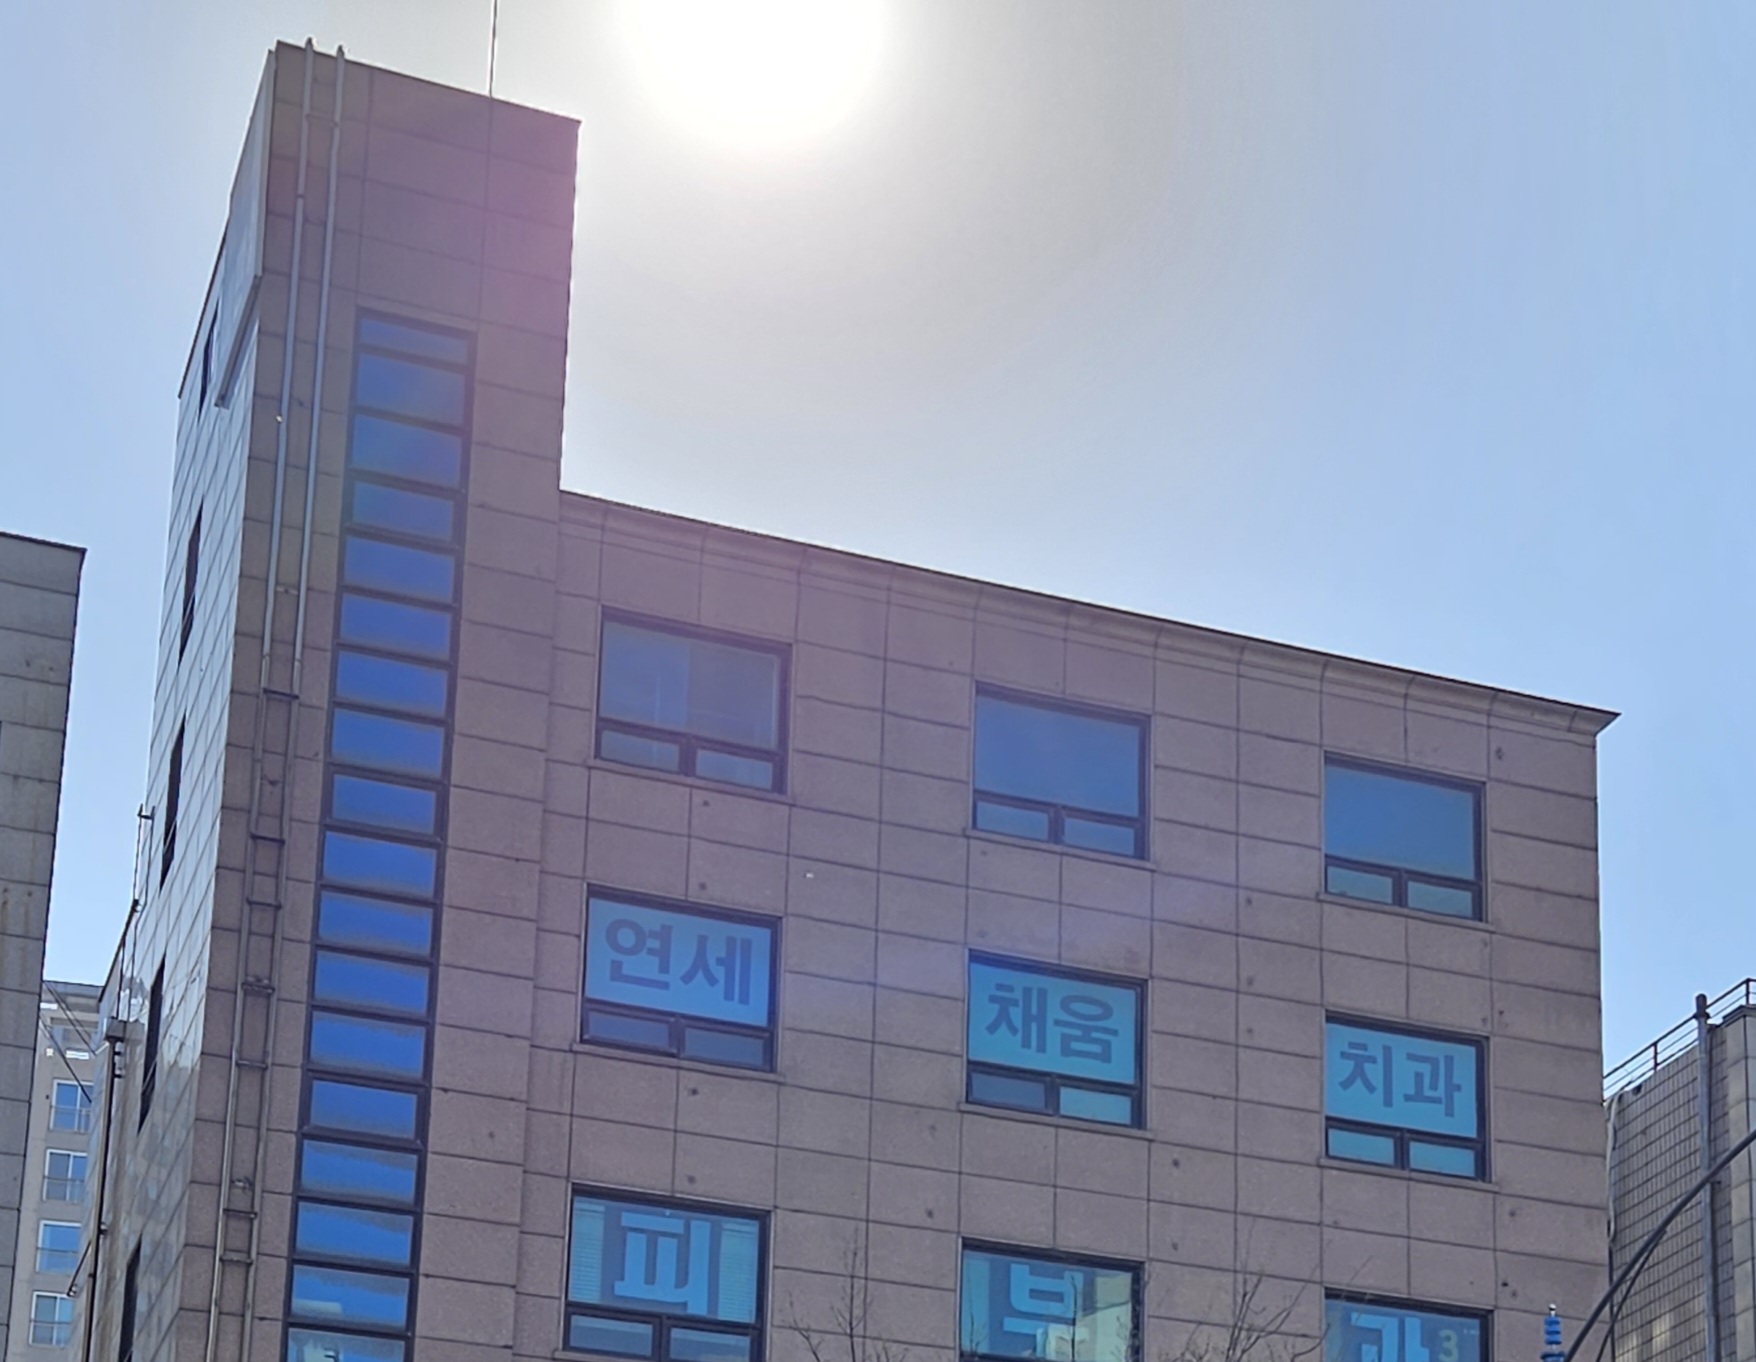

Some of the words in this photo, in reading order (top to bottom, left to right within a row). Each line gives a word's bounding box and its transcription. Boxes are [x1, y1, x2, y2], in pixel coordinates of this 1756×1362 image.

[605, 918, 753, 1006] 연세
[985, 982, 1119, 1064] 채움
[1338, 1041, 1462, 1118] 치과
[614, 1211, 711, 1316] 피
